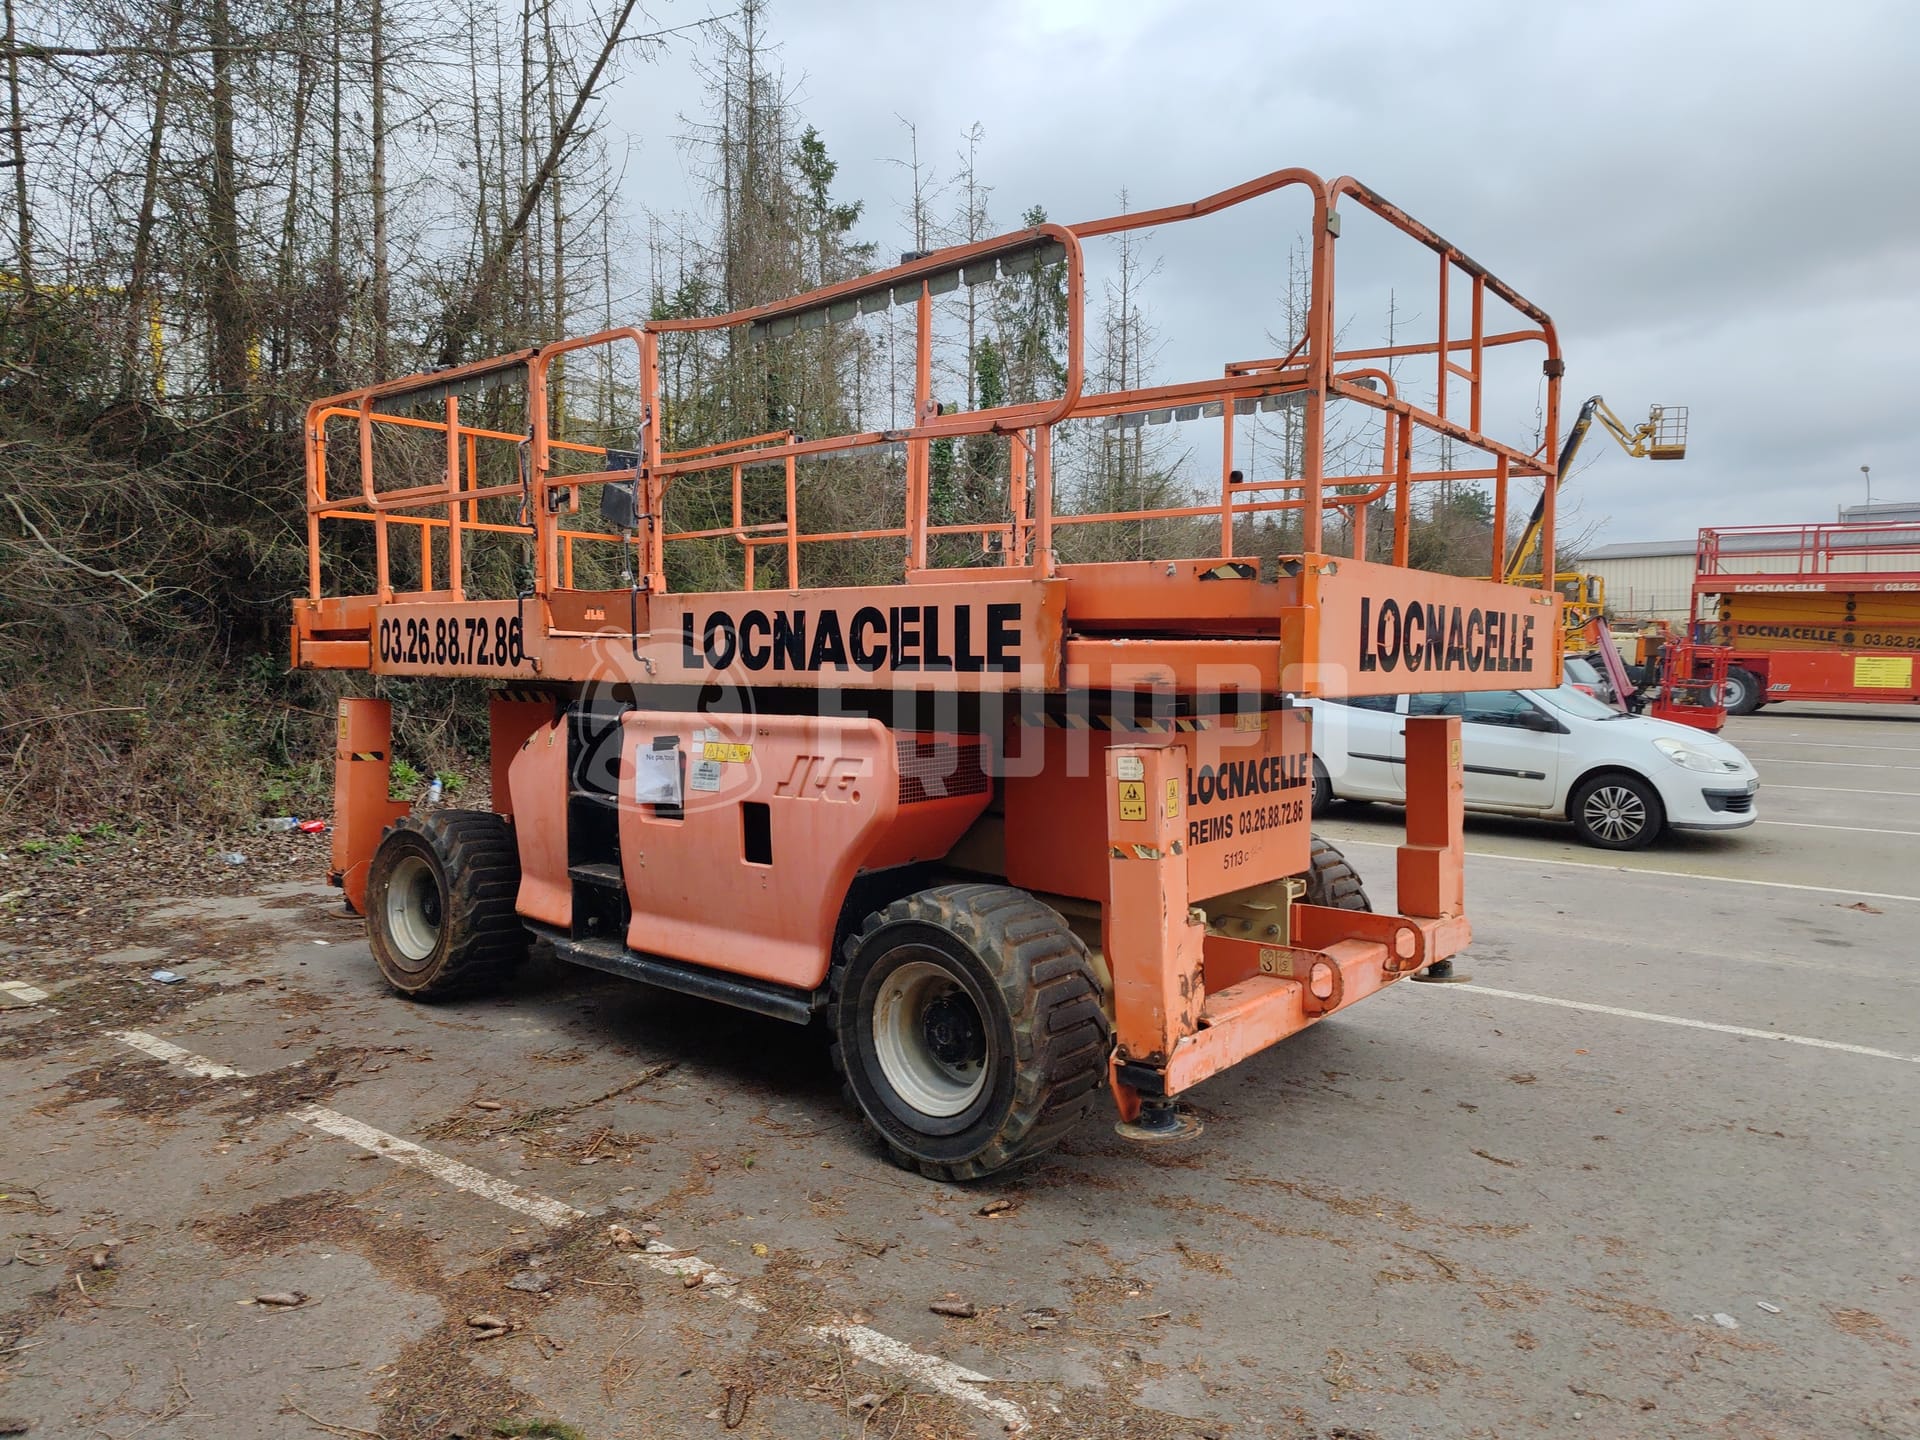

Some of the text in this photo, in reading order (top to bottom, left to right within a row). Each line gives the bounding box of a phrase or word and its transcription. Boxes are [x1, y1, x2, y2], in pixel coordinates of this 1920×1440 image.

[1735, 583, 1826, 593] LOCNACELLE
[380, 616, 522, 667] 03.26.88.72.86
[682, 603, 1022, 673] LOCNACELLE
[1359, 597, 1535, 673] LOCNACELLE
[1737, 624, 1836, 643] LOCNACELLE
[1187, 752, 1308, 806] LOCNACELLE
[1188, 799, 1303, 847] REIMS 03.26.88.72.86
